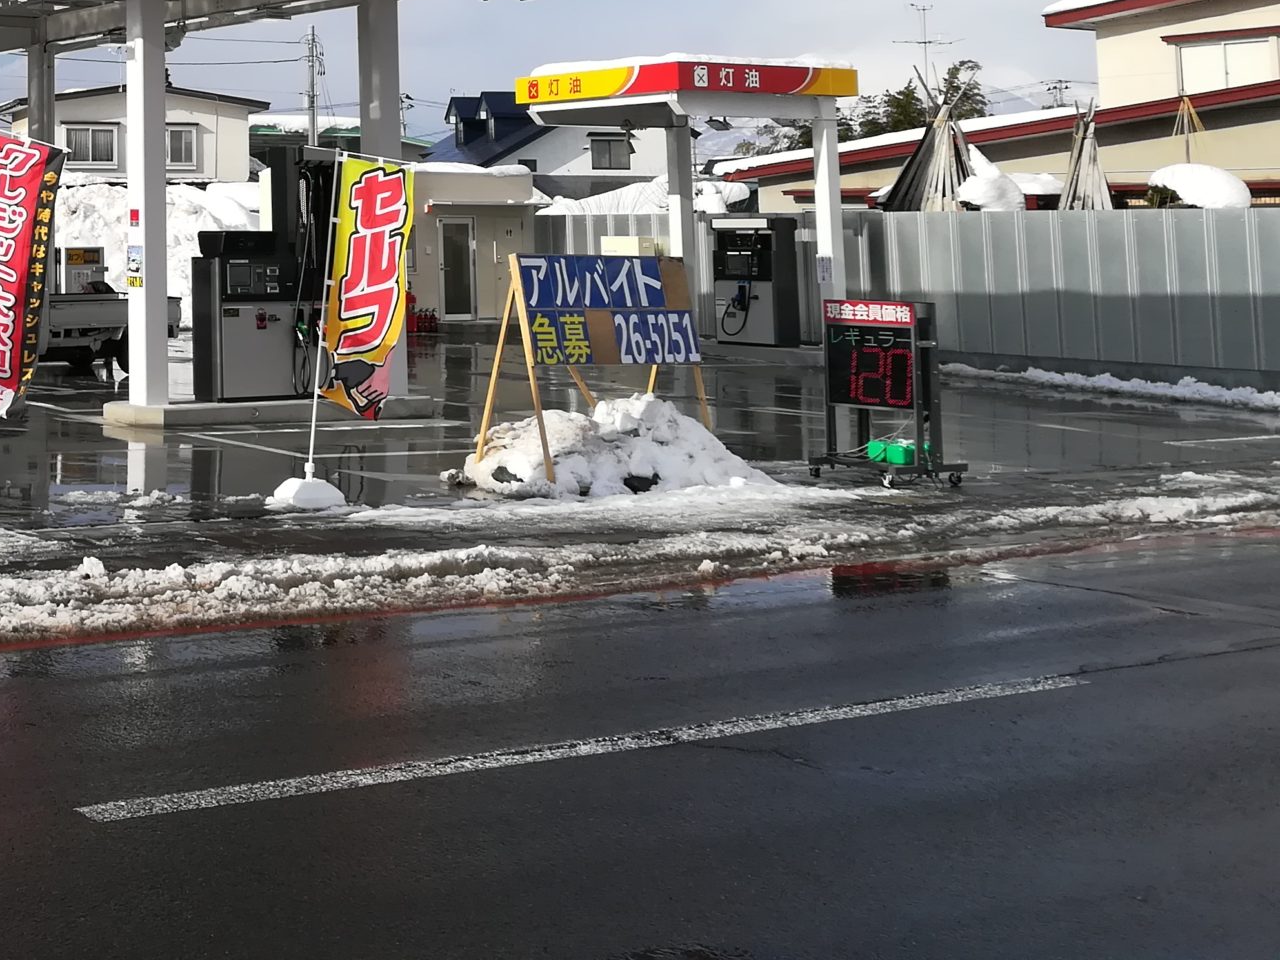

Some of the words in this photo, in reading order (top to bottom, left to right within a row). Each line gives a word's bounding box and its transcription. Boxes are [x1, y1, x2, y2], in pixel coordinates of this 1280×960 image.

[548, 77, 582, 97] 灯油
[720, 68, 760, 89] 灯油
[340, 172, 404, 351] セルフ
[520, 257, 662, 308] アルバイト
[826, 302, 911, 323] 現金会員価格
[830, 327, 913, 347] レギュラー
[531, 312, 591, 365] 急募
[614, 312, 702, 365] 26-5251
[849, 346, 913, 406] 120
